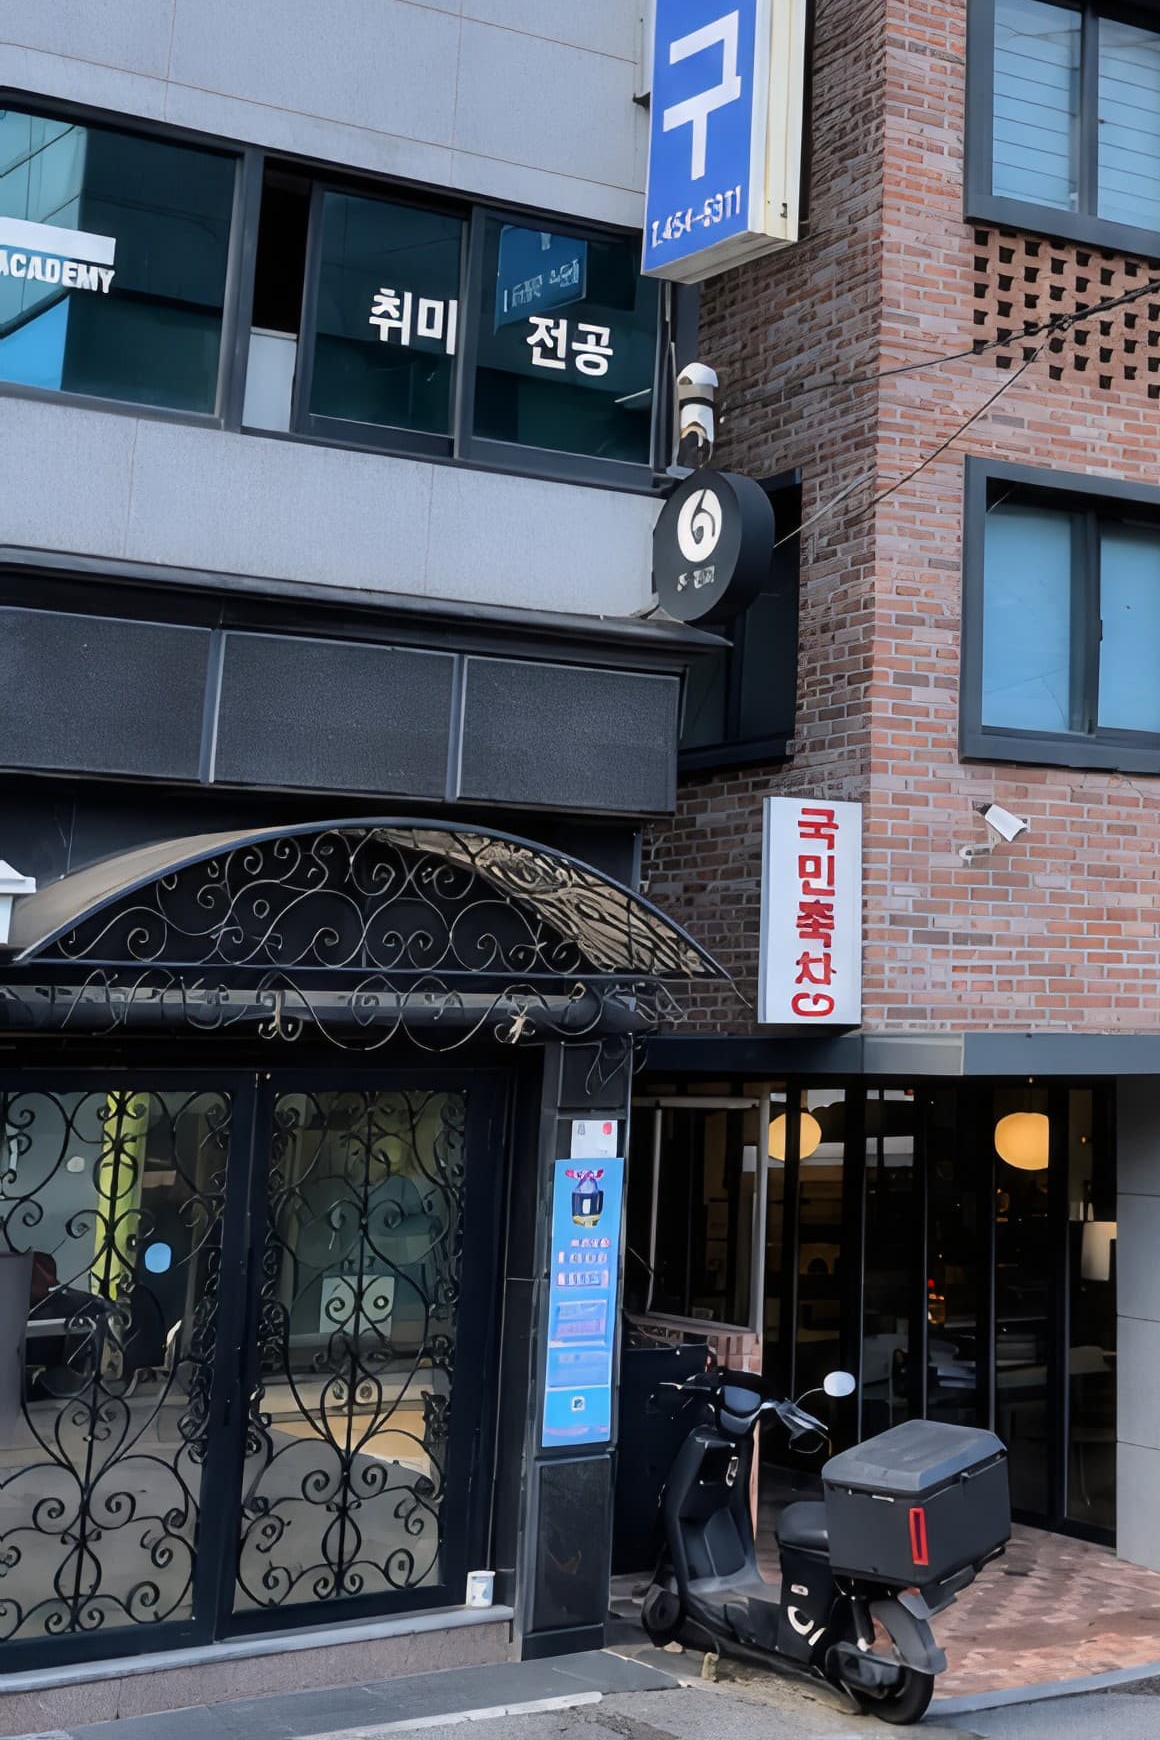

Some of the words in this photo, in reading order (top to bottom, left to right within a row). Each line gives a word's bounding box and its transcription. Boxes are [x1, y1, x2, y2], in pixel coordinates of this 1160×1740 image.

[0, 248, 115, 294] ACADEMY
[368, 286, 459, 356] 취미
[526, 315, 615, 378] 전공
